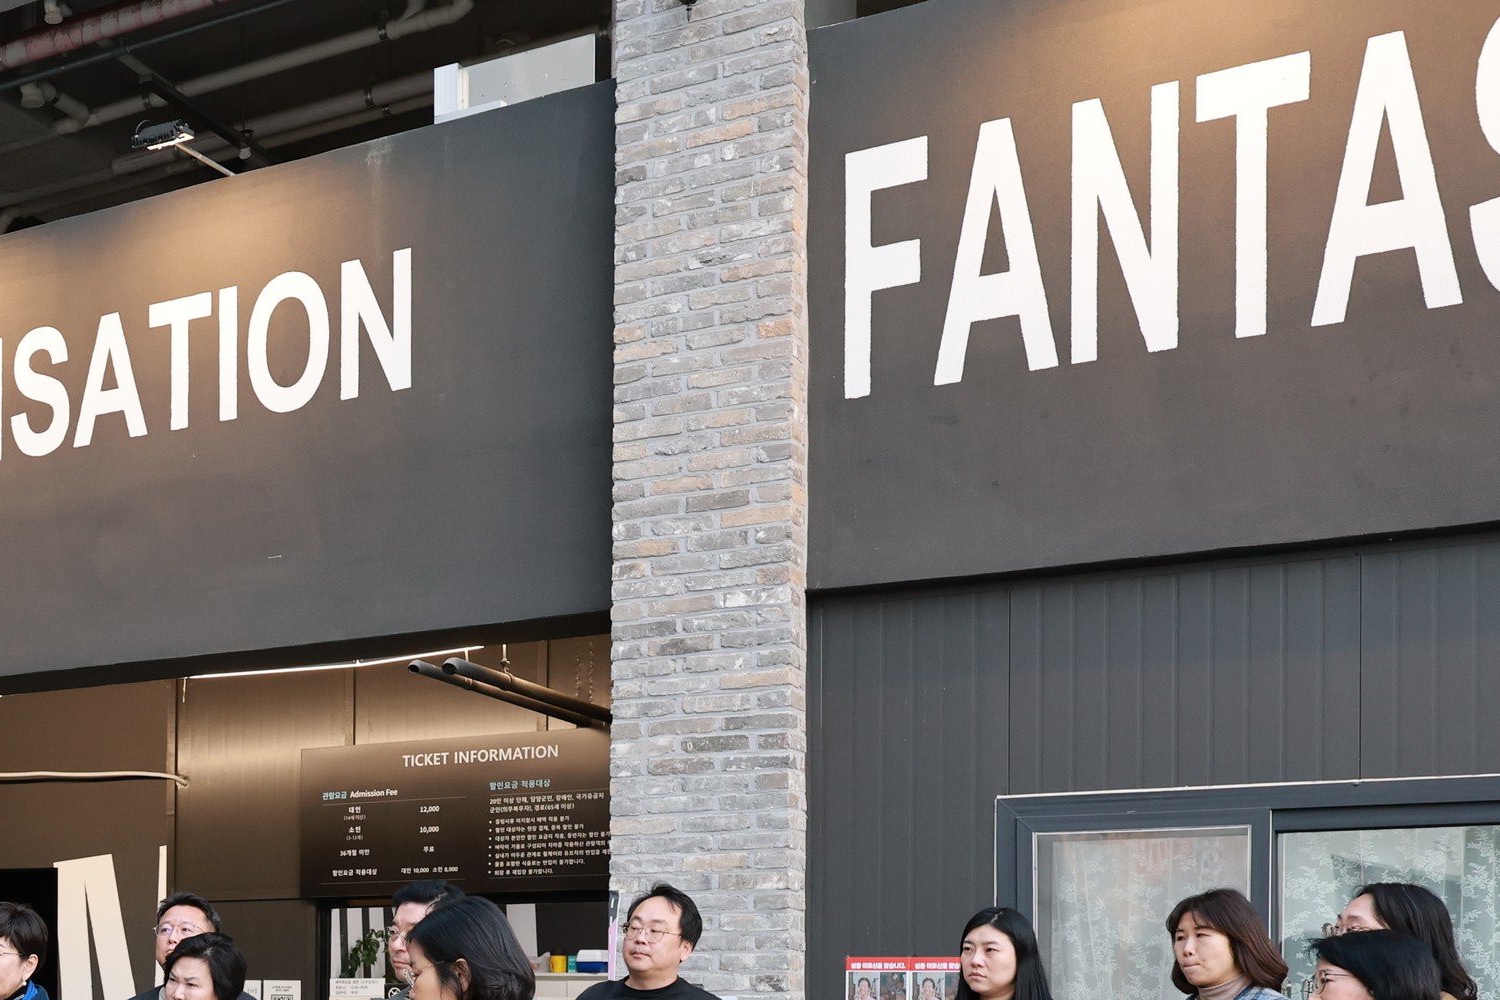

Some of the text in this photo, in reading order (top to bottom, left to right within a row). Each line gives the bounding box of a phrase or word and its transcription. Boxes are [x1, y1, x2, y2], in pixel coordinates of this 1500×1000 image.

[844, 17, 1500, 399] FANTA
[402, 745, 559, 767] TICKET INFORMATION
[490, 779, 550, 790] 할인요금 적용대상
[322, 791, 347, 800] 관람요금
[350, 790, 385, 798] Admission
[420, 826, 439, 834] 10,000
